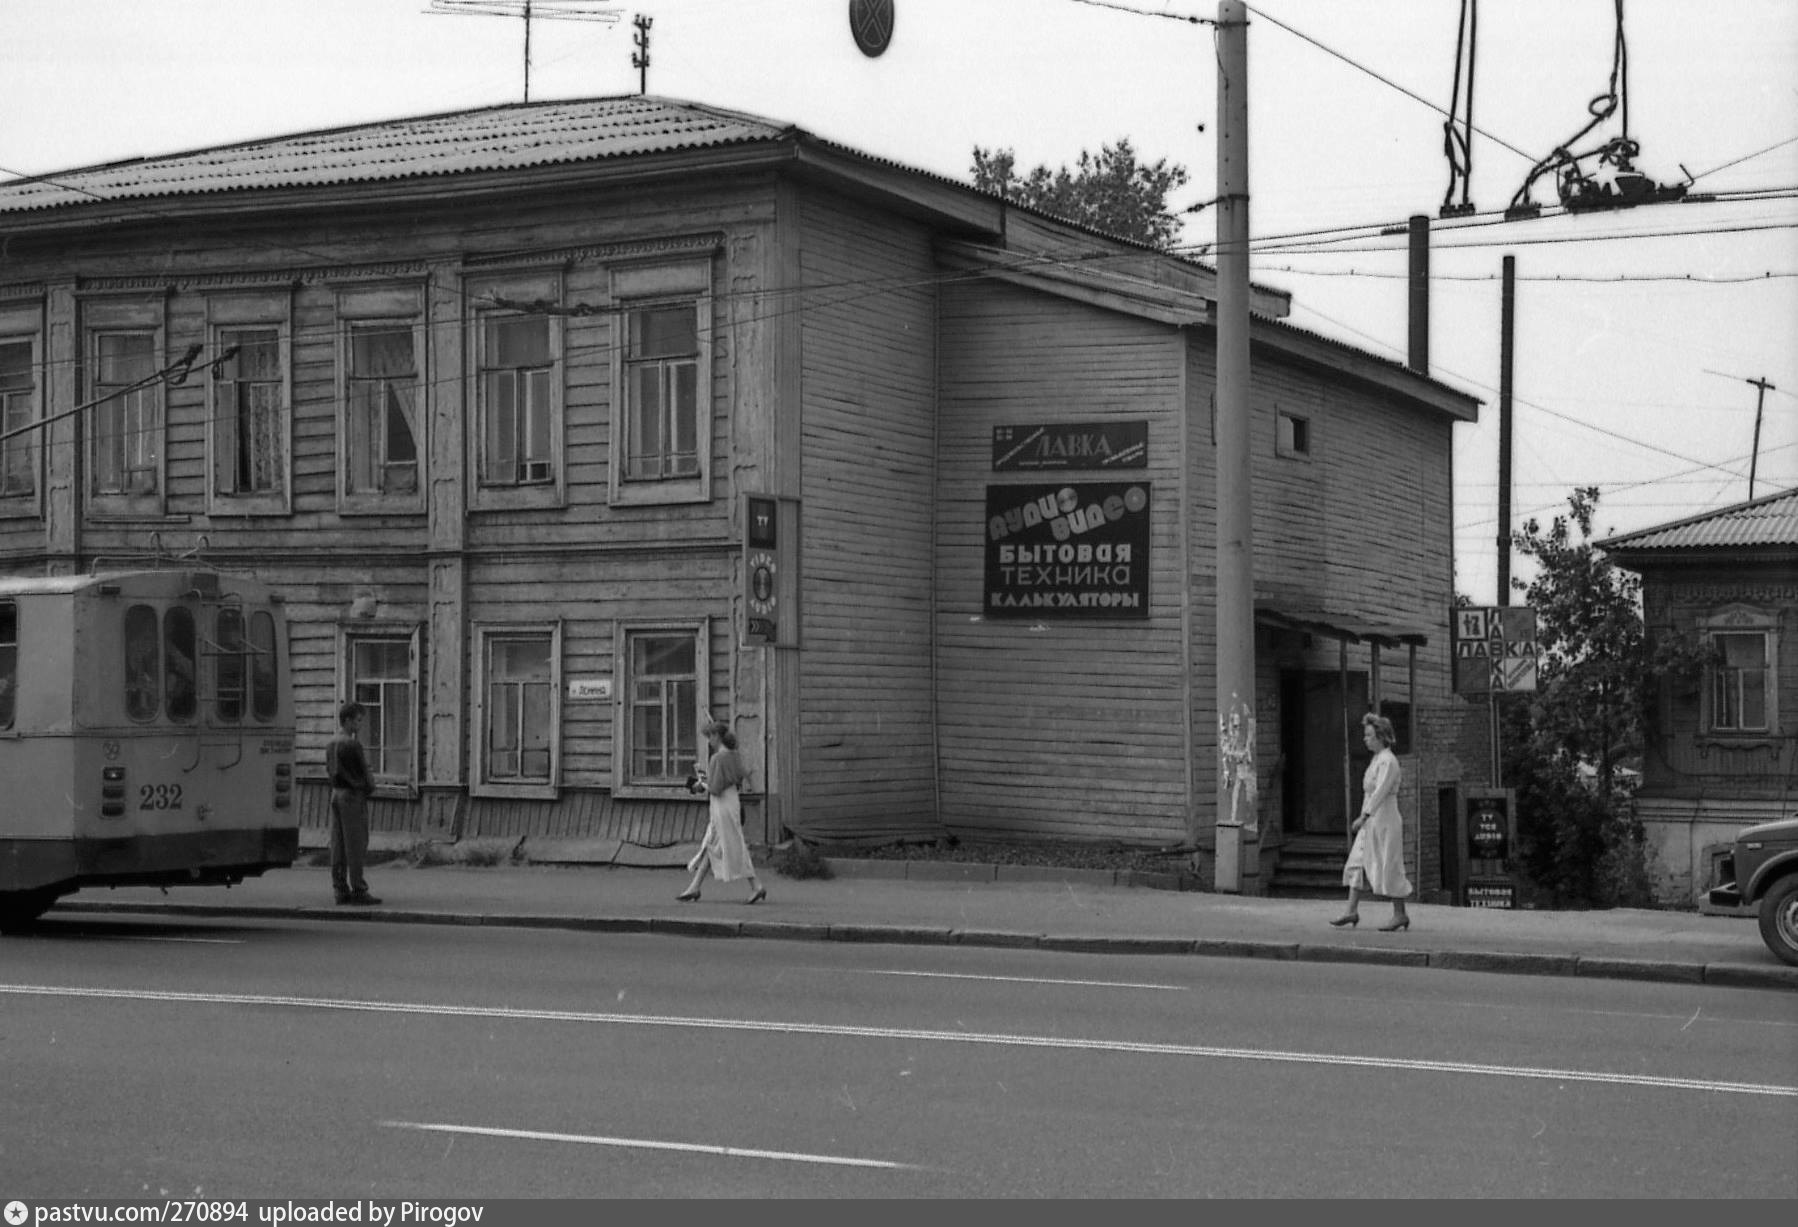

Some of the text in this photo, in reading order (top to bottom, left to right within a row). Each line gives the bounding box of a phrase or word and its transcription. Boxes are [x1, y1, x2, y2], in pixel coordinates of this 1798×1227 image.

[1036, 434, 1112, 456] ЛАВКА
[991, 593, 1139, 608] КАЛЬКУЛЯТОРЫ
[1458, 641, 1536, 658] ЛАВКА
[140, 784, 182, 810] 232
